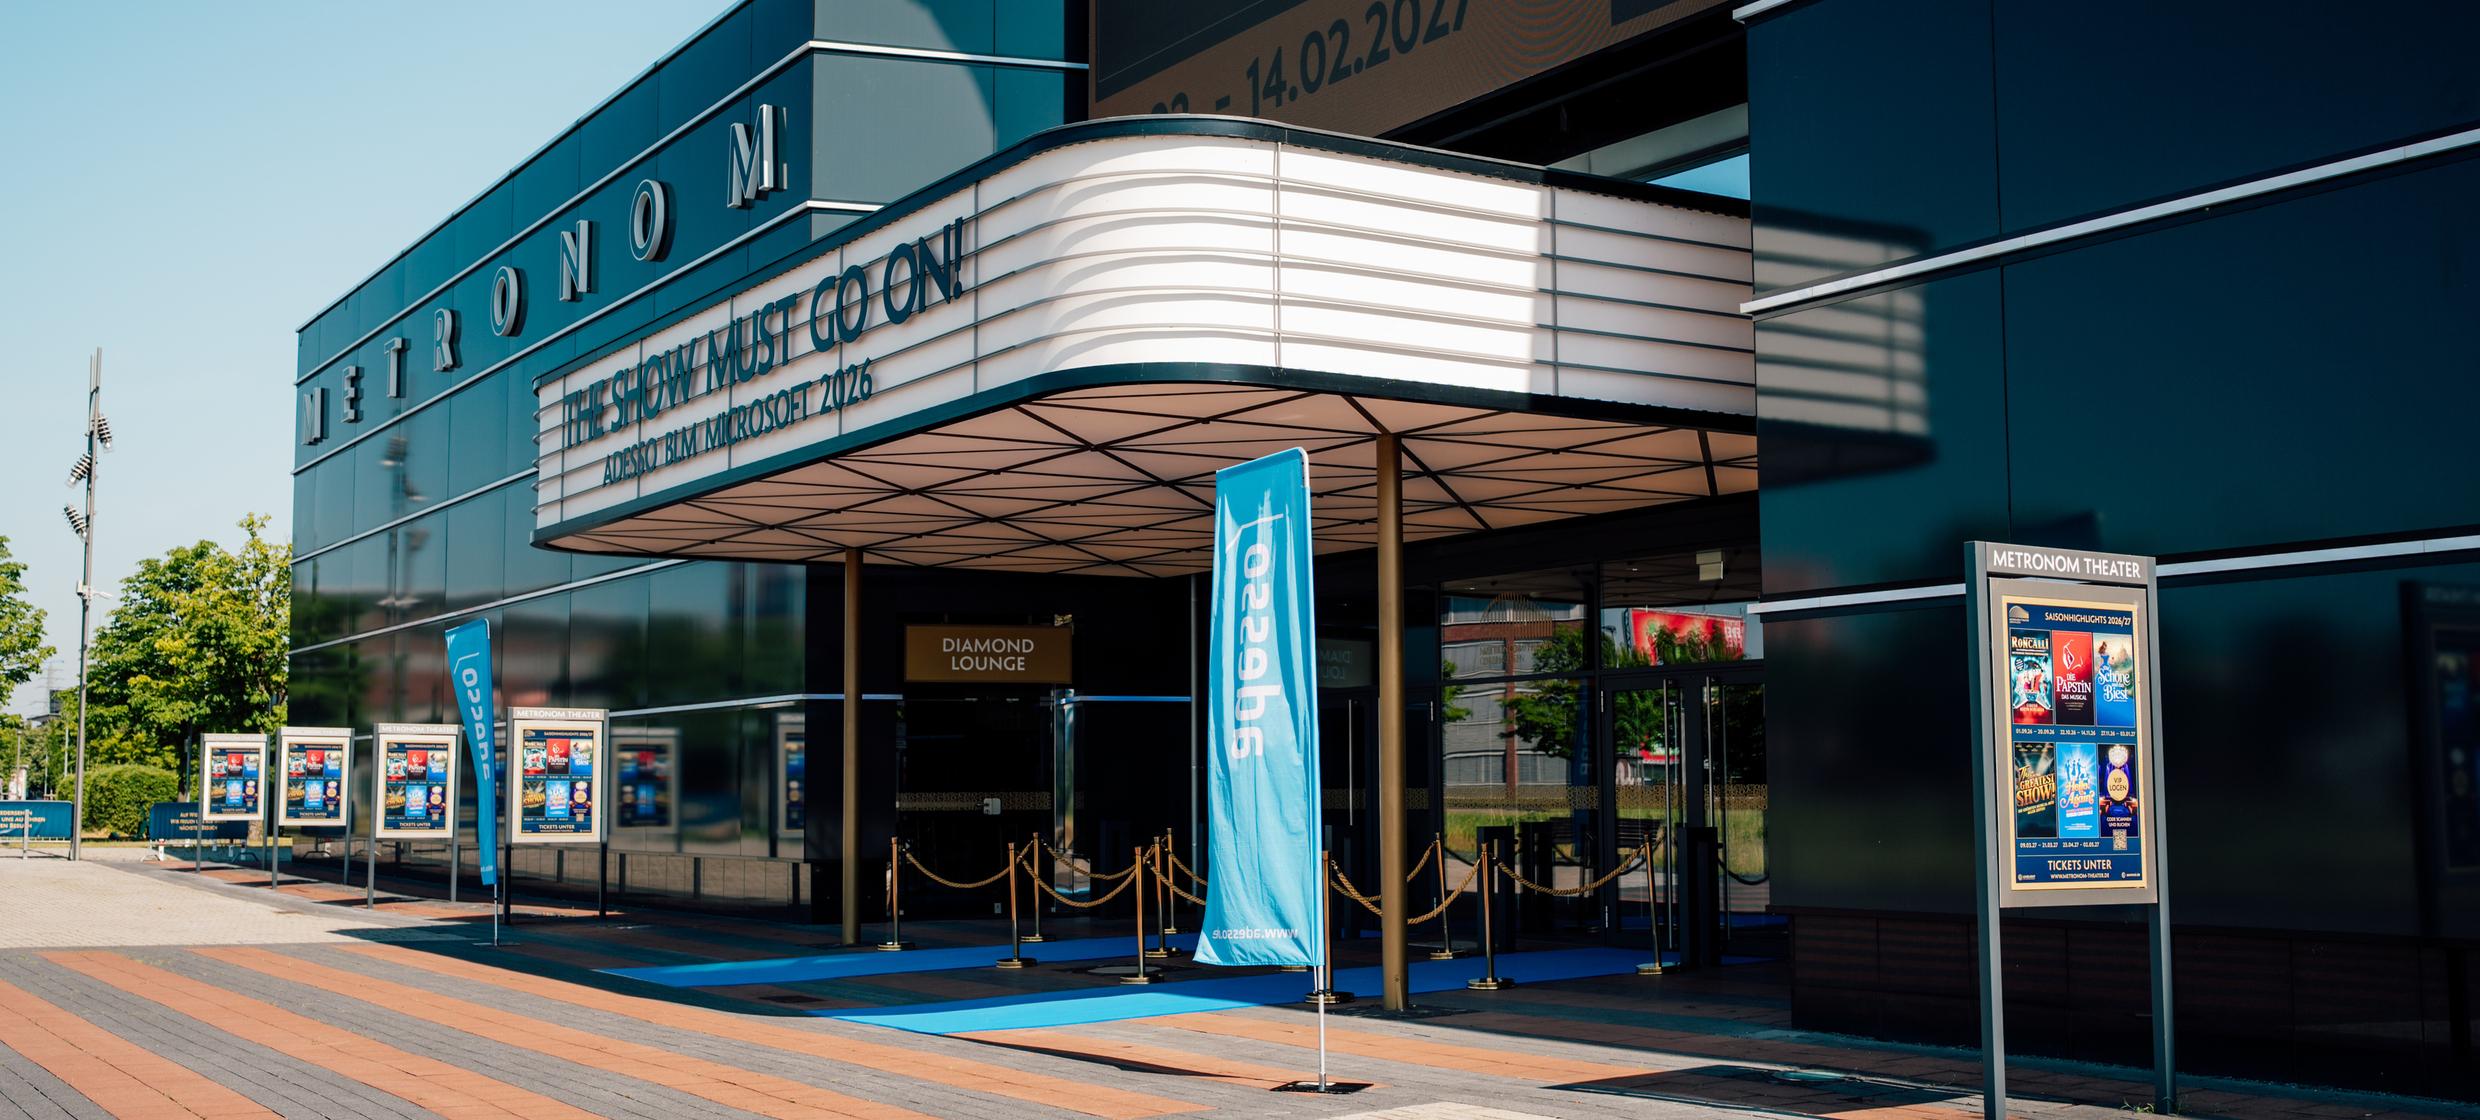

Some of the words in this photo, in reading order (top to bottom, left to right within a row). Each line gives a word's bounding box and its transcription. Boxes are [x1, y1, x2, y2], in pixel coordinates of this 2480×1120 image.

[301, 104, 774, 445] METRONOM
[564, 379, 605, 449] THE
[611, 337, 697, 433] SHOW
[706, 293, 797, 395] MUST
[810, 264, 868, 352] GO
[883, 216, 965, 325] ON!
[602, 437, 658, 488] ADESSO
[664, 422, 698, 467] BLM
[705, 380, 812, 449] MICROSOFT
[820, 357, 874, 415] 2026
[1993, 550, 2080, 573] METRONOM
[2083, 557, 2141, 579] THEATER
[2044, 611, 2106, 624] SAISONHIGHLIGHTS
[2107, 616, 2131, 628] 2026/27
[943, 638, 1034, 654] DIAMOND
[2011, 636, 2049, 650] RONCALLI
[952, 656, 1025, 671] LOUNGE
[2047, 859, 2081, 871] TICKETS
[2083, 859, 2112, 870] UNTER
